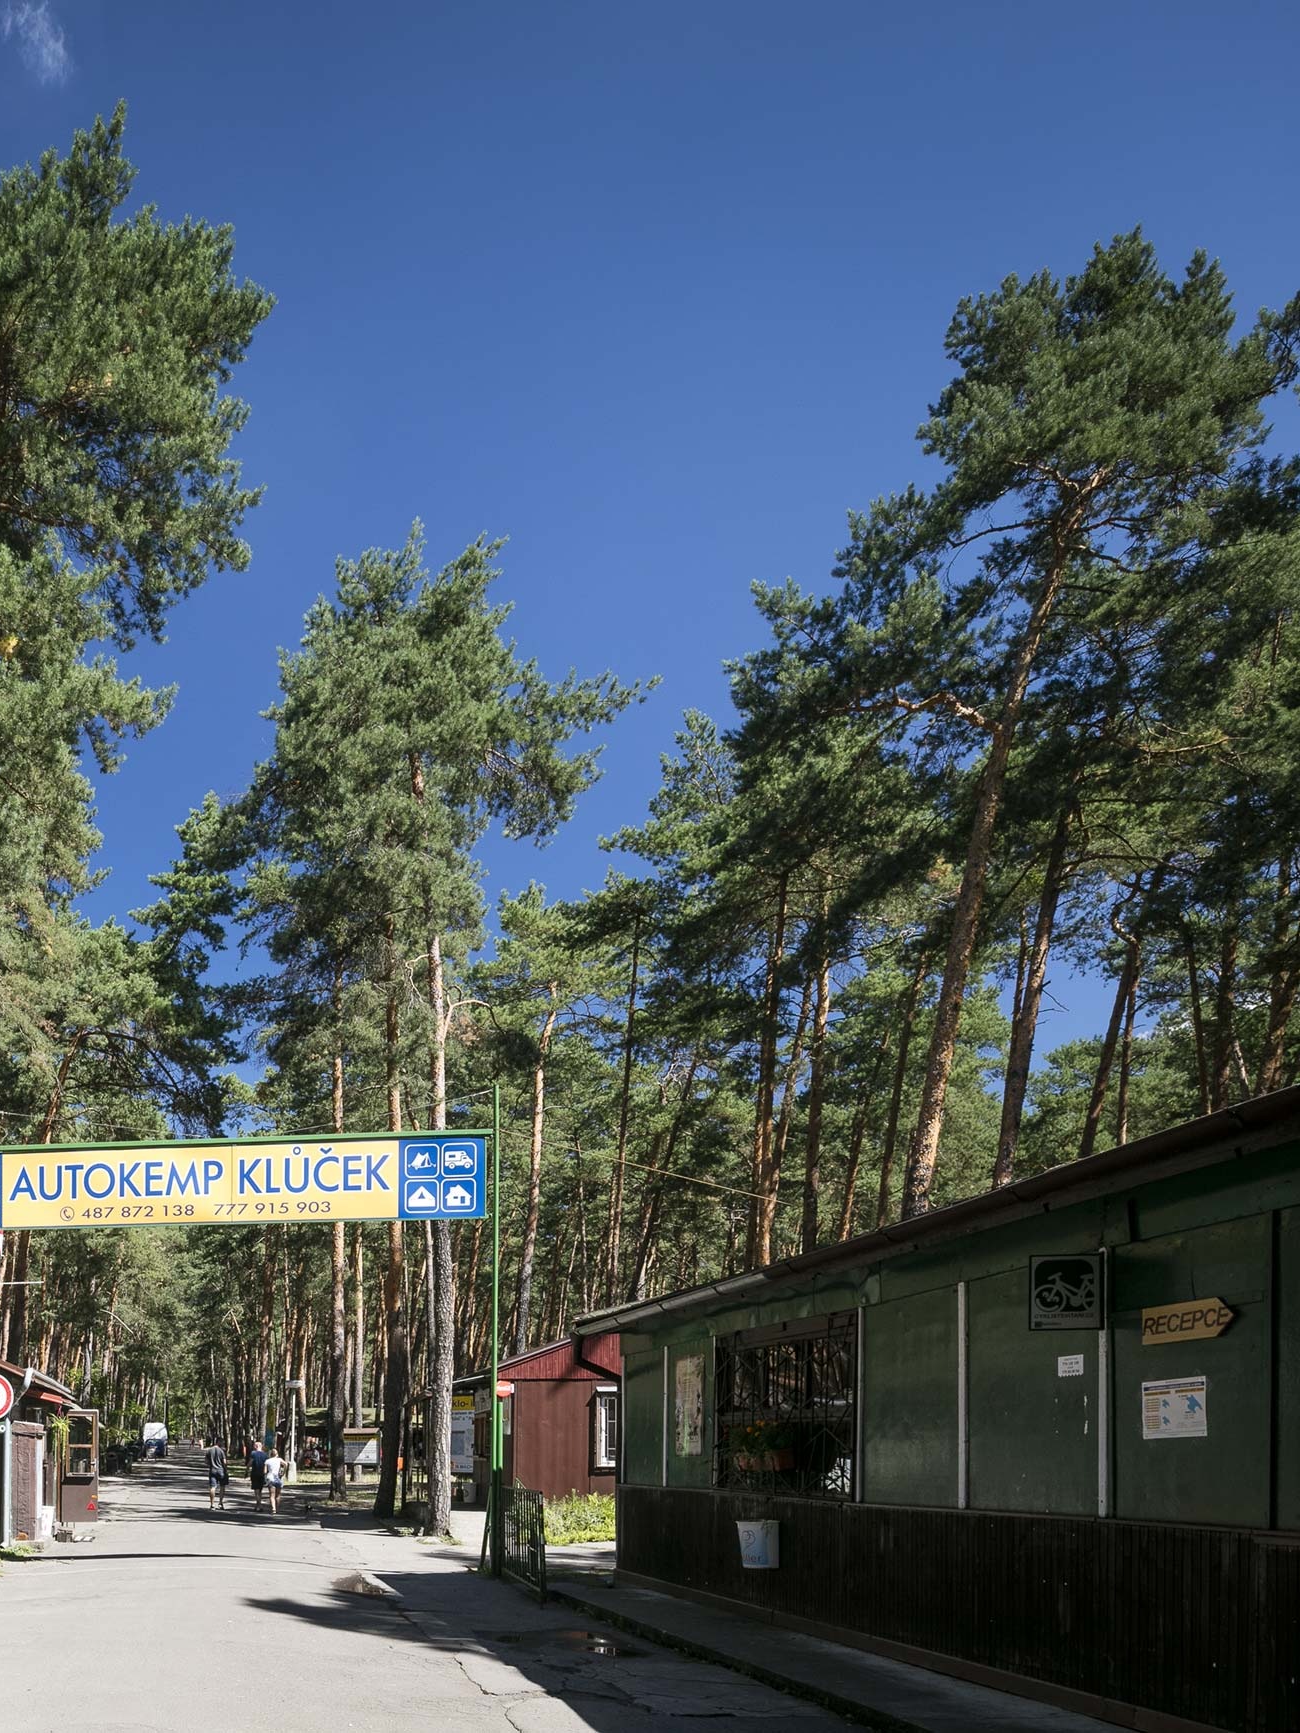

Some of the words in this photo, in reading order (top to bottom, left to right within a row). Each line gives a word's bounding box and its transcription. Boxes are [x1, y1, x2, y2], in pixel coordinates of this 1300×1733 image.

[8, 1160, 225, 1201] AUTOKEMP
[238, 1146, 391, 1195] KLŮČEK
[81, 1206, 115, 1219] 487
[120, 1205, 154, 1218] 872
[162, 1204, 195, 1217] 138
[213, 1203, 248, 1216] 777
[255, 1202, 289, 1215] 915
[296, 1201, 332, 1214] 903
[1142, 1307, 1229, 1336] RECEPCE
